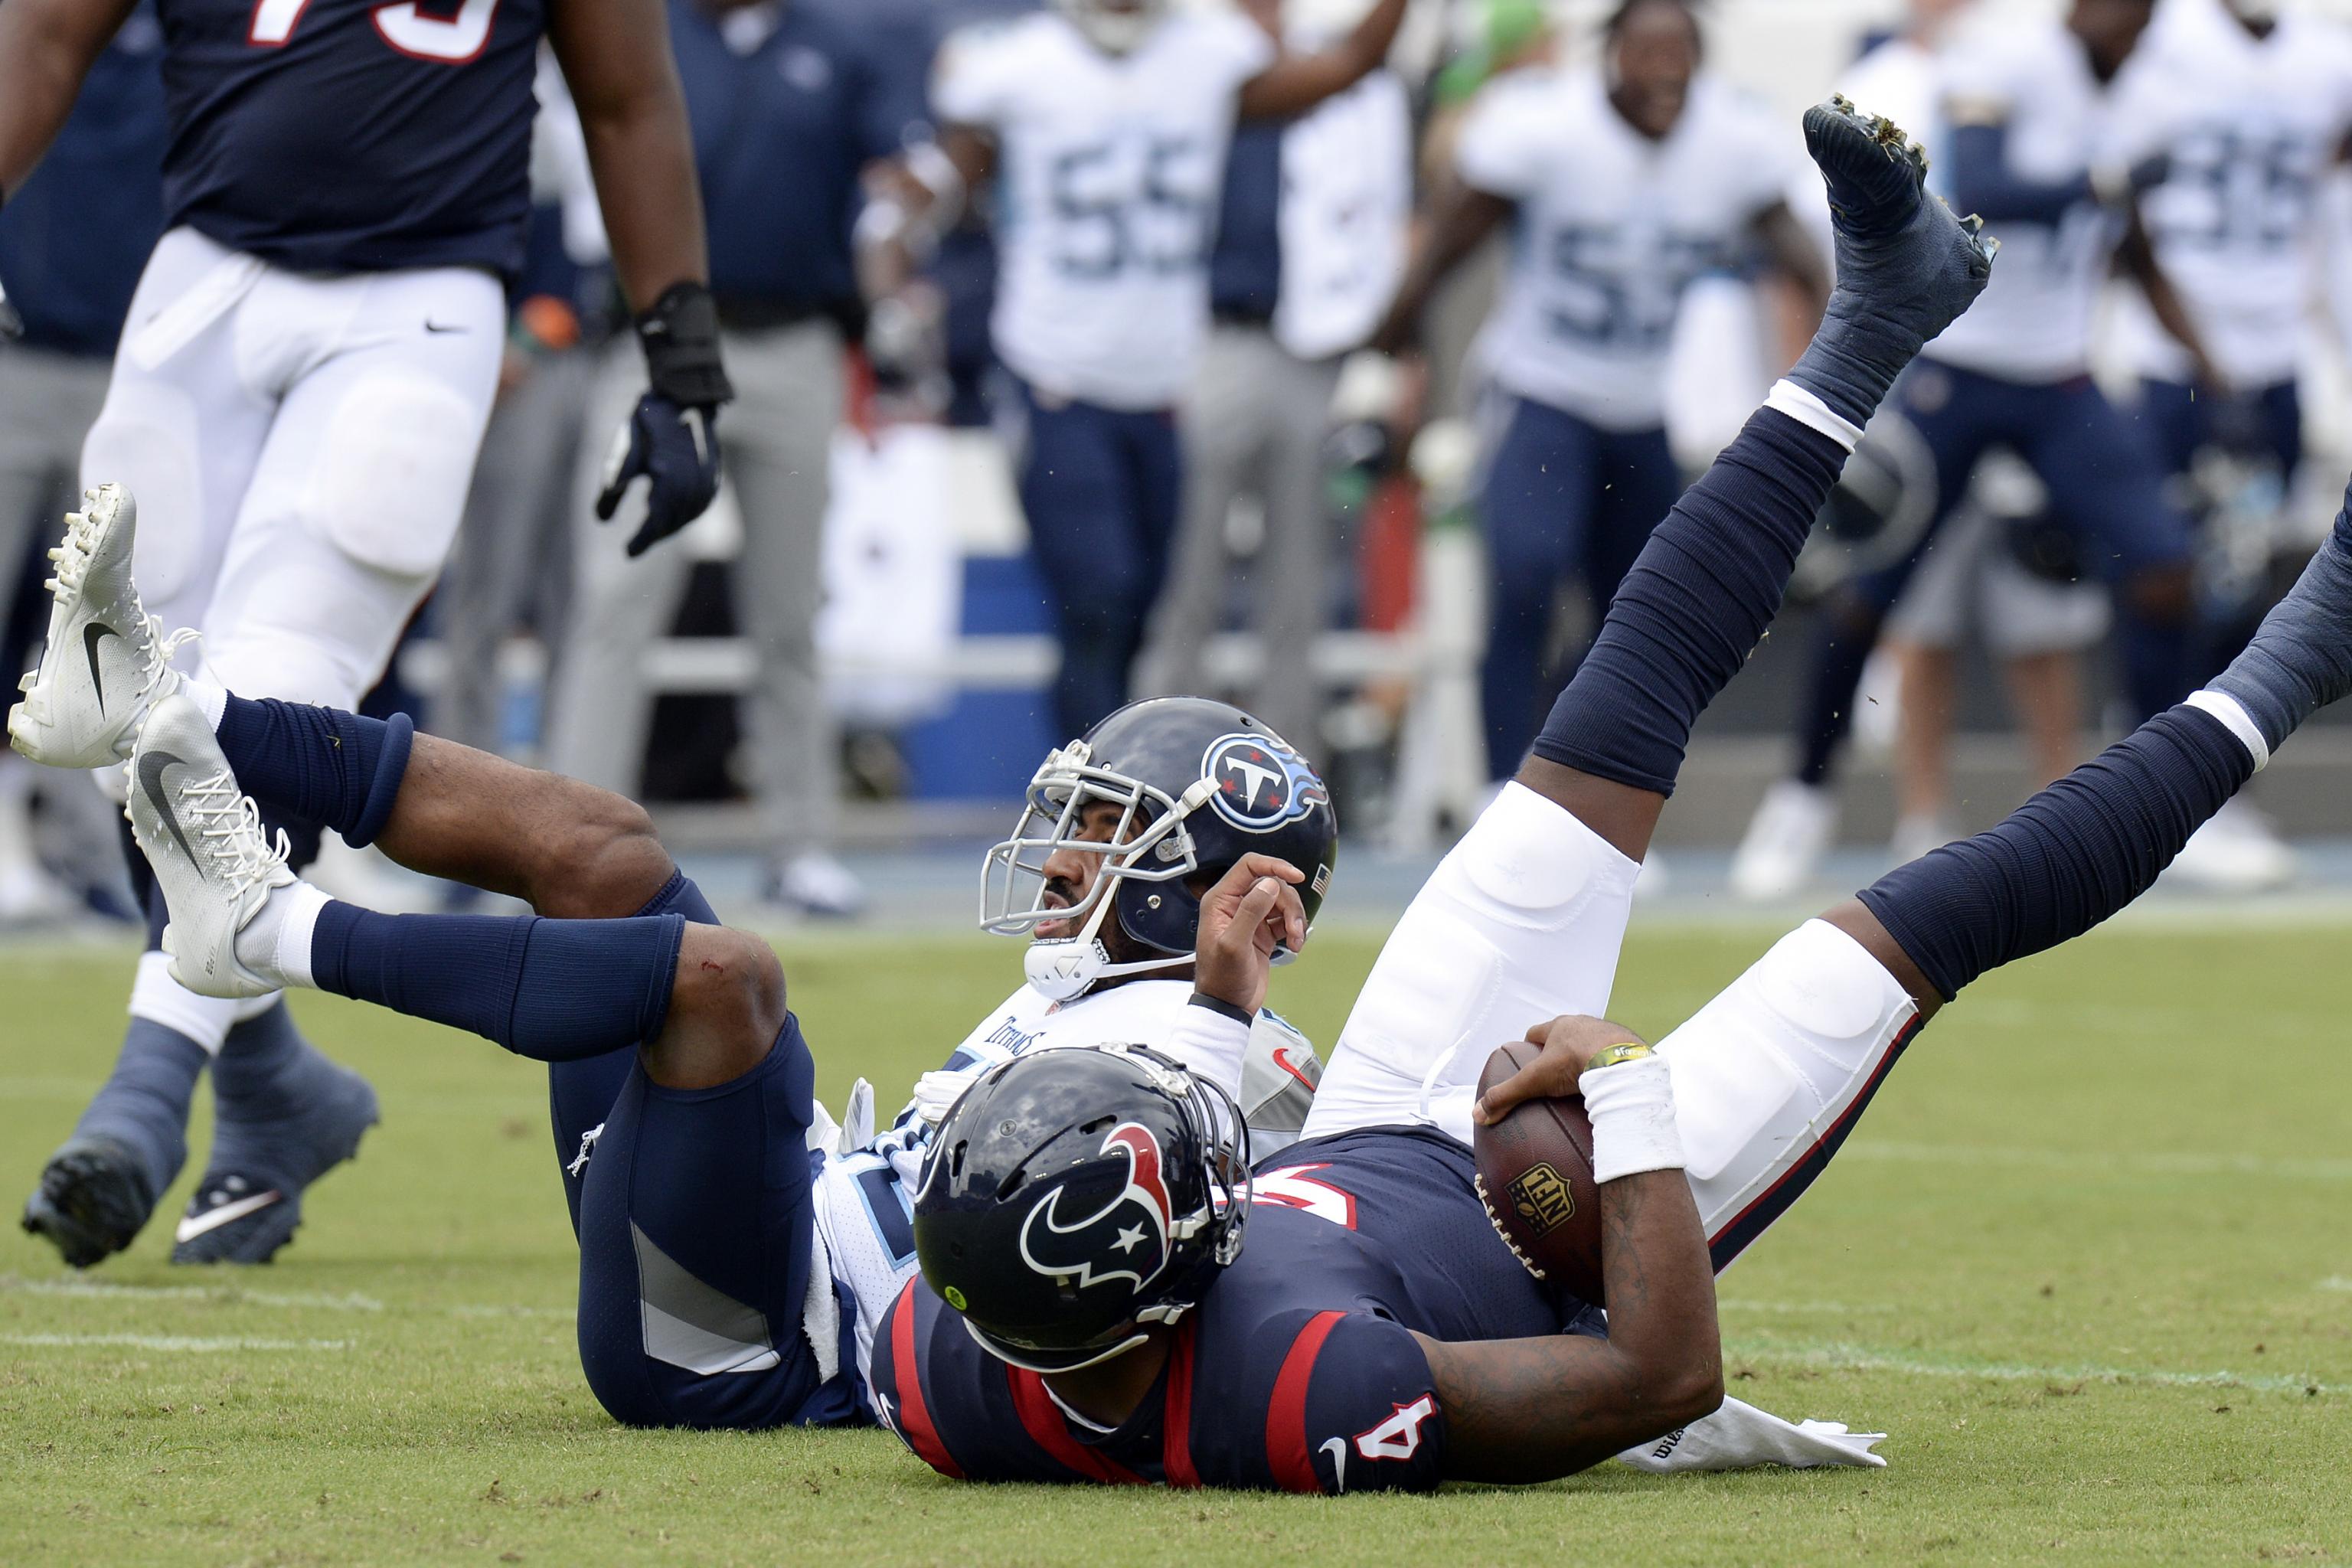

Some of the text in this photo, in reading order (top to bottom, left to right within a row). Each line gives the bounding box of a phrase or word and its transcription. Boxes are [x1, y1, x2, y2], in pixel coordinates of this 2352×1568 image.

[983, 1015, 1047, 1057] TITANS
[1527, 1168, 1569, 1223] NFL
[1352, 1392, 1436, 1462] 4
